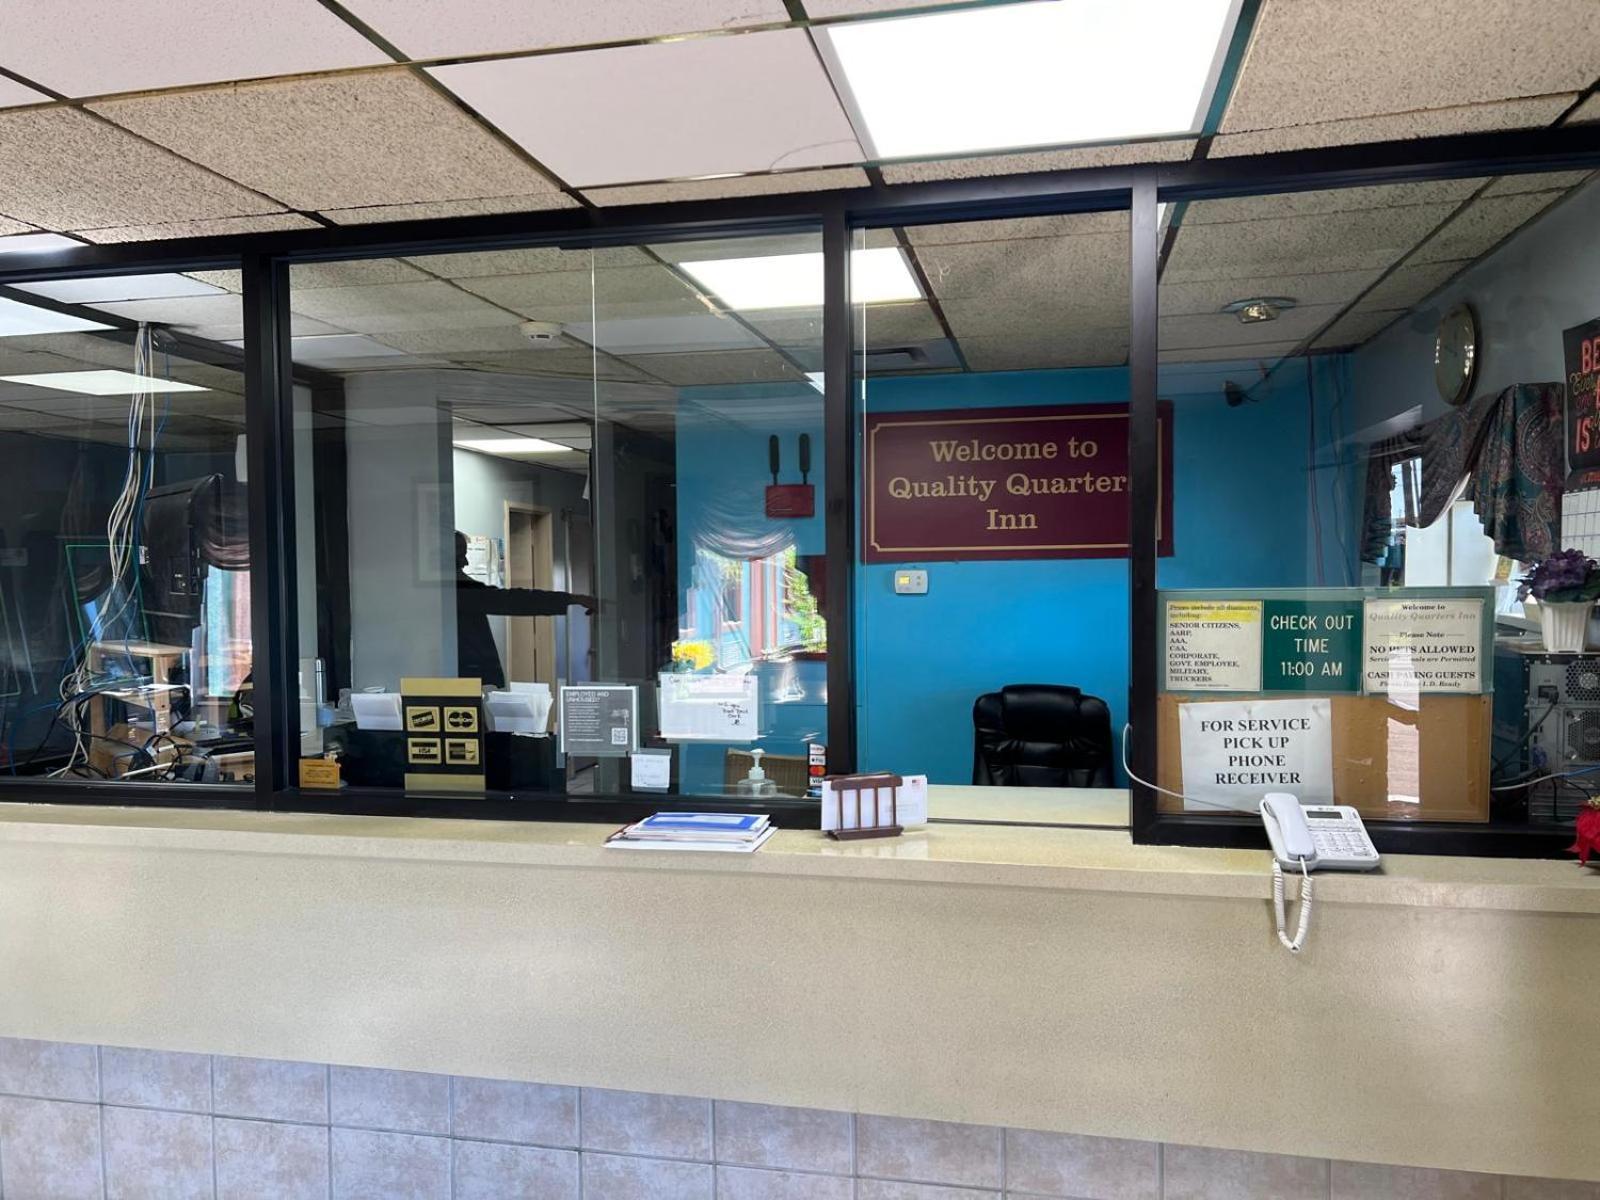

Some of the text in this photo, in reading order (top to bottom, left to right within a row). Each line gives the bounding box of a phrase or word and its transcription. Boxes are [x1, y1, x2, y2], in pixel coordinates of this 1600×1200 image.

[928, 436, 1098, 462] Welcome to
[888, 471, 1131, 501] Quality Quarter
[986, 508, 1038, 530] Inn
[1402, 603, 1436, 611] Welcome
[1270, 615, 1355, 631] CHECK OUT
[1369, 611, 1477, 622] Quality Quarters Inn
[1294, 638, 1329, 653] TIME
[1281, 661, 1343, 676] 11:00 AM
[1435, 671, 1476, 679] GUESTS
[1201, 718, 1311, 732] FOR SERVICE
[1224, 736, 1289, 749] PICK UP
[1229, 755, 1286, 767] PHONE
[1216, 772, 1301, 784] RECEIVER
